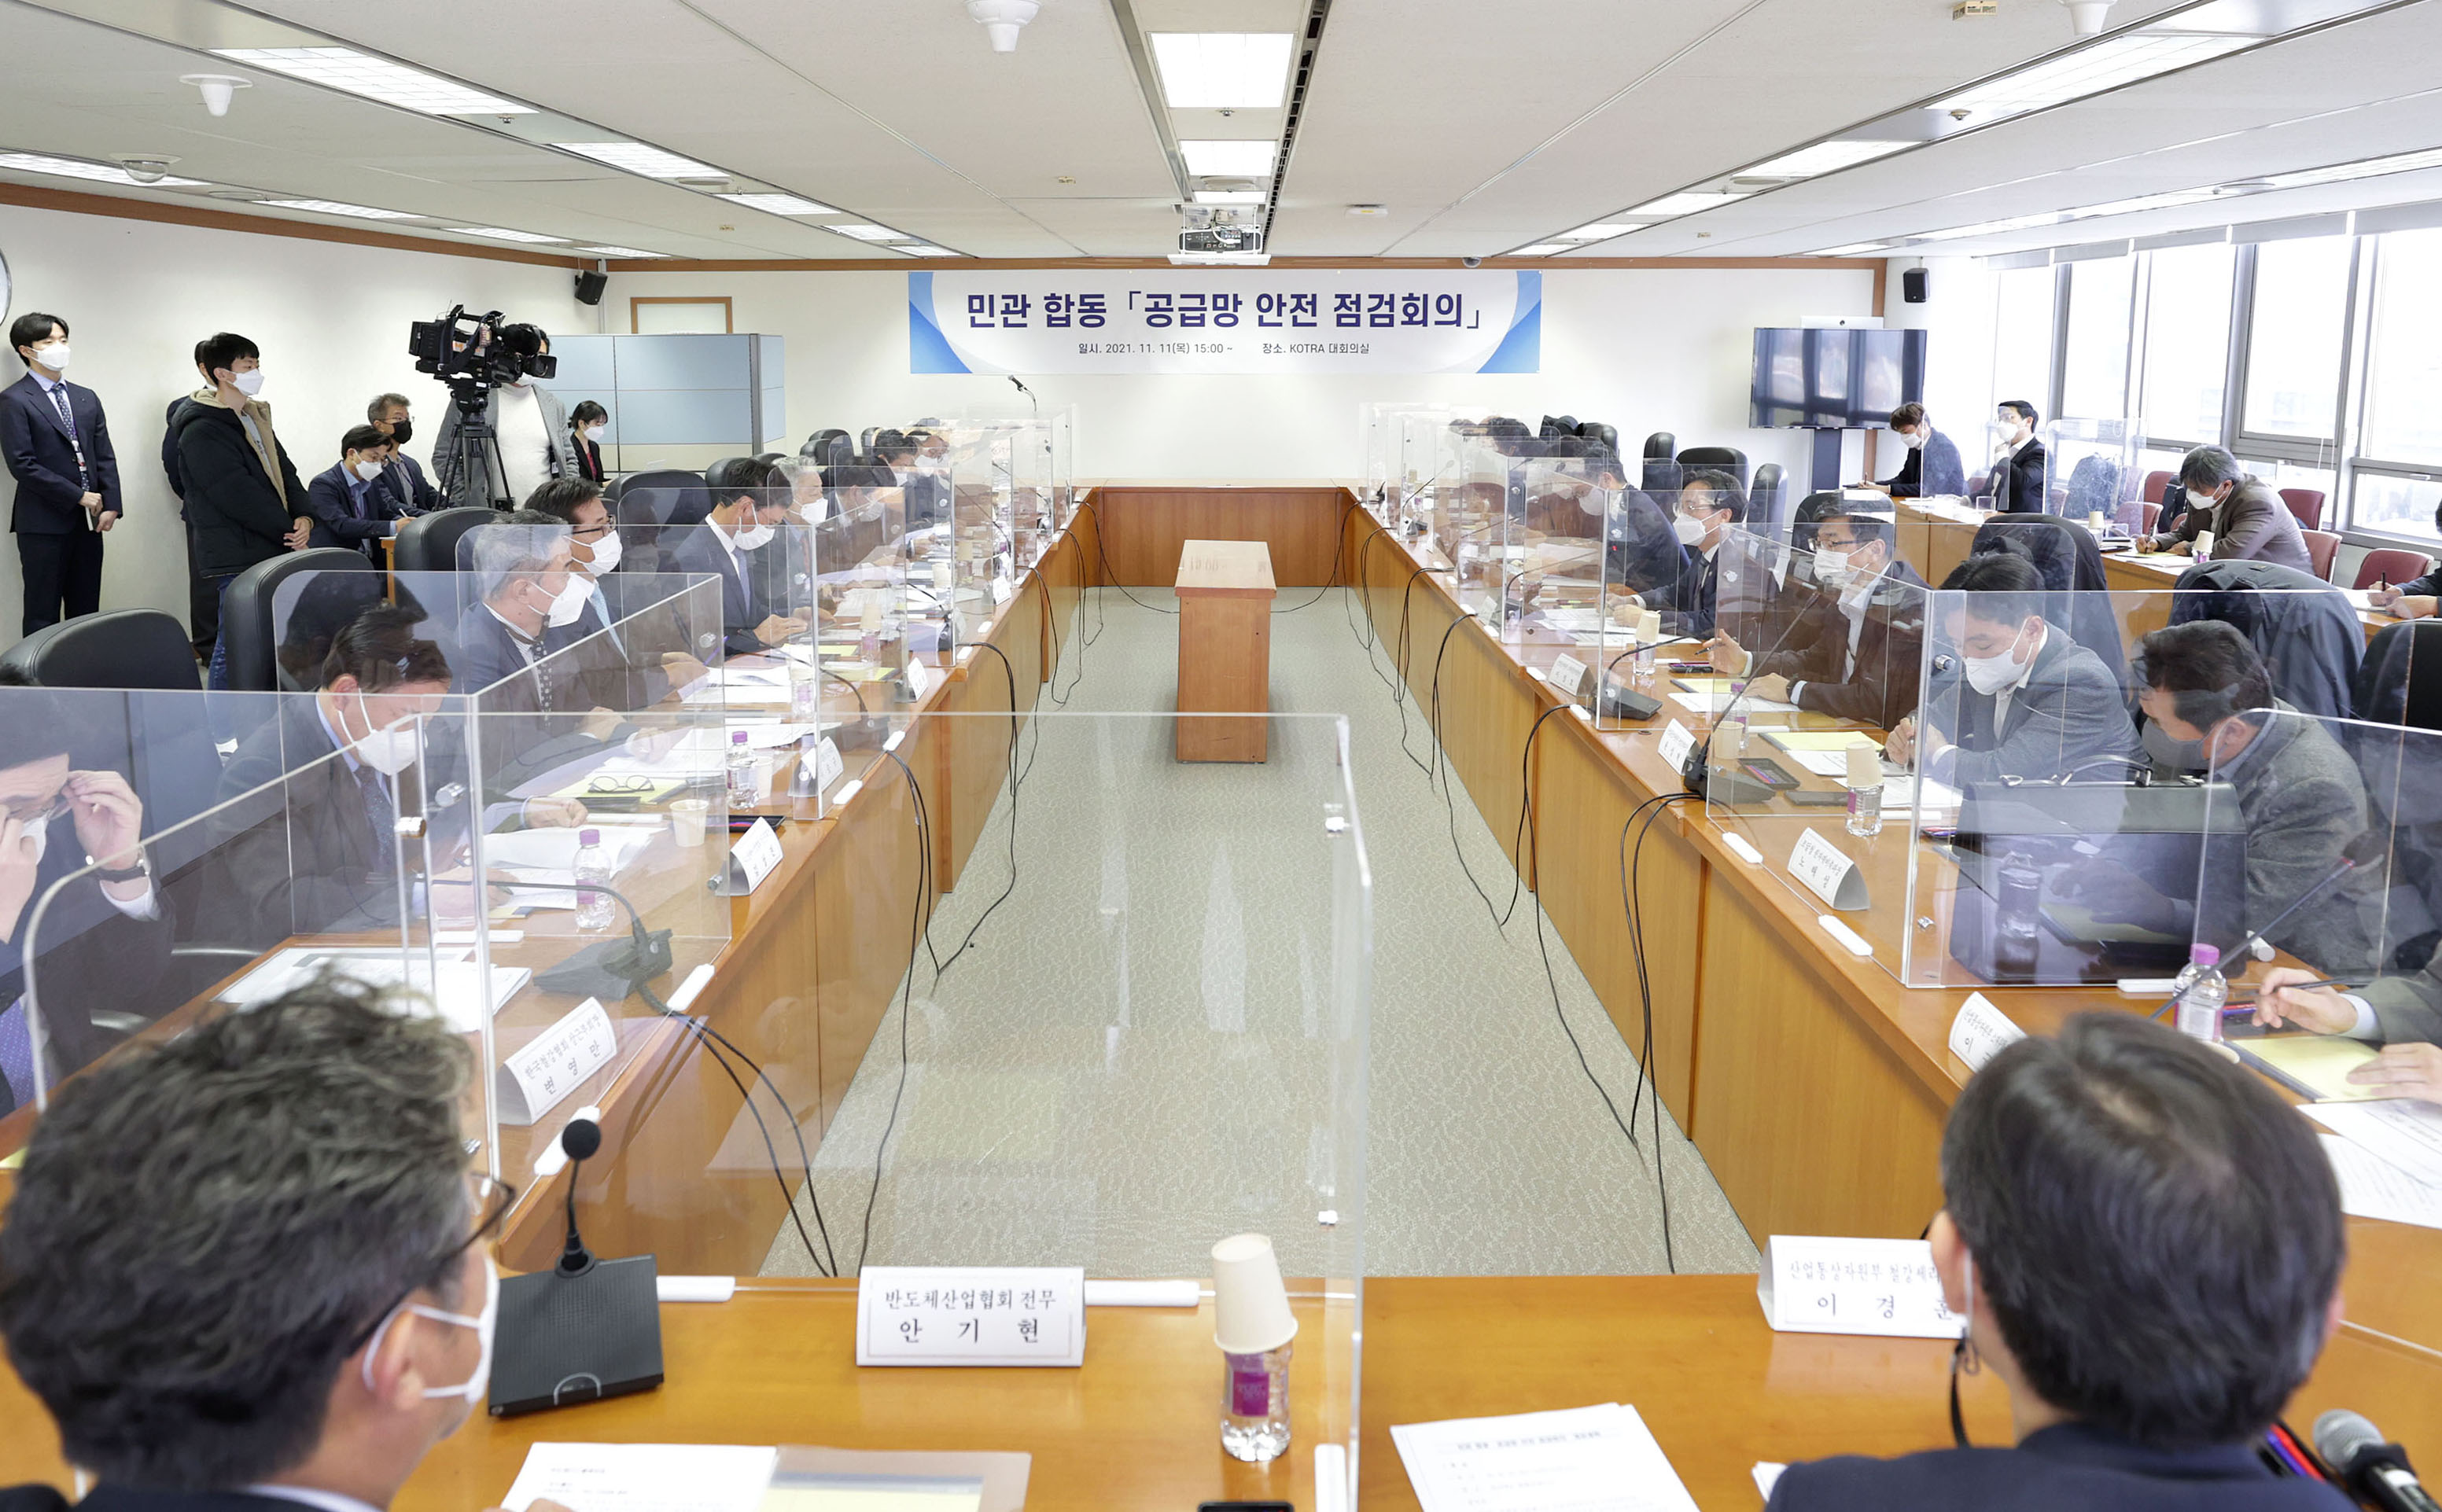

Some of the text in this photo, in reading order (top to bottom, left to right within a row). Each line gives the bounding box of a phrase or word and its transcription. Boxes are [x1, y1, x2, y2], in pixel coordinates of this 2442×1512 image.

[967, 292, 1032, 329] 민관
[1043, 292, 1107, 329] 합동
[1256, 292, 1318, 328] 안전
[1078, 343, 1102, 354] 일시.
[1105, 343, 1135, 354] 2021.
[1140, 343, 1155, 354] 11.
[1159, 342, 1190, 355] 11(목)
[1194, 343, 1224, 354] 15:00
[1262, 342, 1370, 355] 장소. KOTRA 대회의실
[1789, 1260, 1883, 1282] 산업통상자원부
[885, 1289, 1057, 1310] 반도체산업협회 전무
[1817, 1293, 1836, 1316] 이
[1877, 1295, 1895, 1319] 경
[899, 1317, 1040, 1344] 안 기 현
